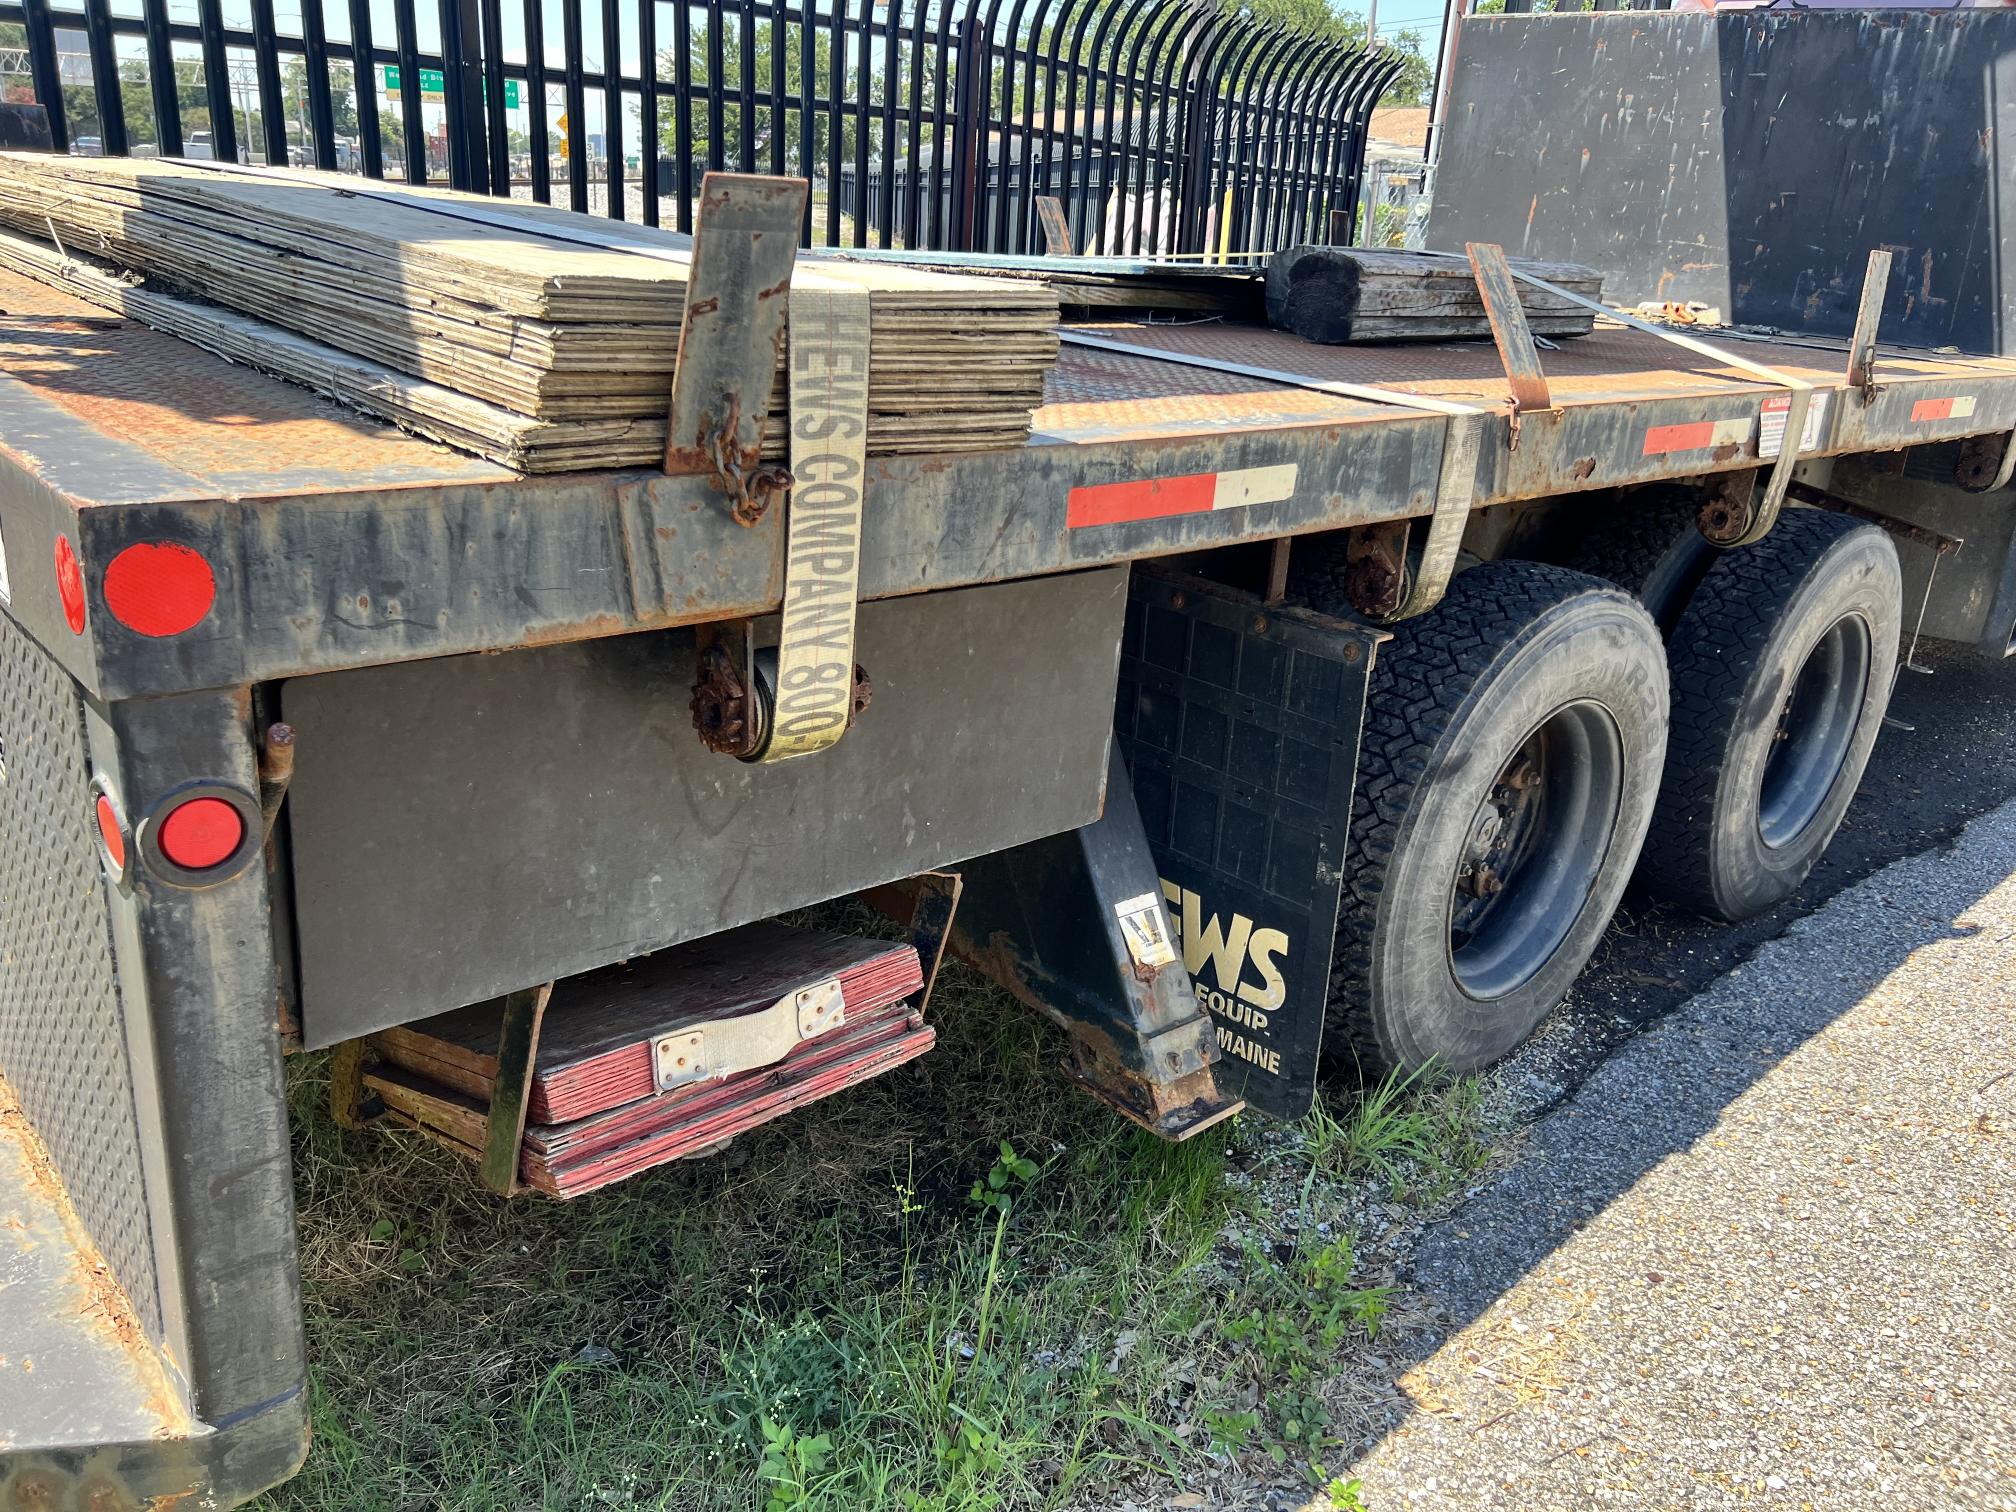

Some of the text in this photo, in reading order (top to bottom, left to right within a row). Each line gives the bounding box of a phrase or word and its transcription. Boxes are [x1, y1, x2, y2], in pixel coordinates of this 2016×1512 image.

[793, 315, 866, 441] HEWS
[784, 454, 861, 651] COMPANY
[1216, 1027, 1281, 1075] MAINE
